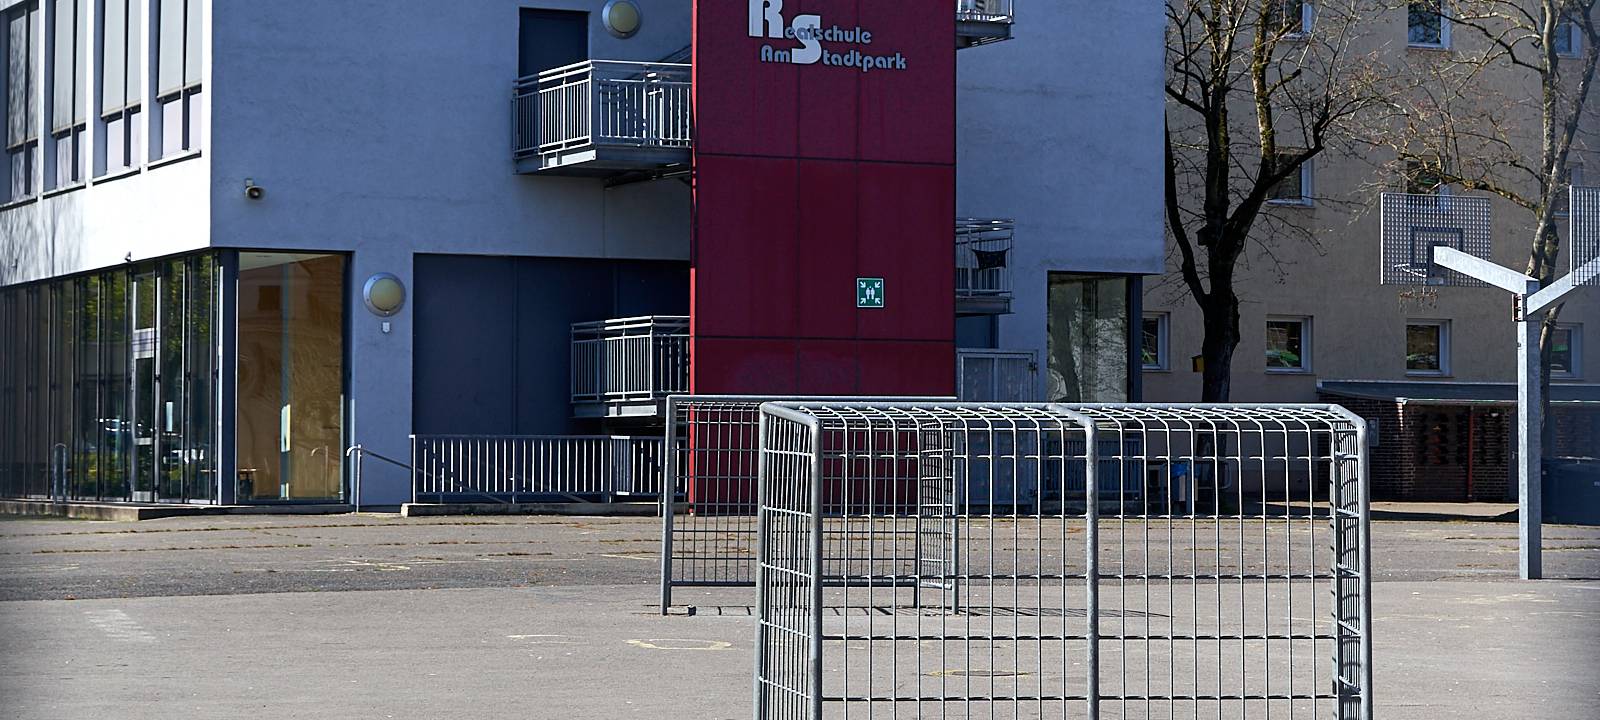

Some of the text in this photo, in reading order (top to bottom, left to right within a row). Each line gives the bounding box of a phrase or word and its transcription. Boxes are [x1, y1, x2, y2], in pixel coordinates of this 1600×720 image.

[748, 0, 872, 43] Realschule
[760, 14, 907, 72] Am Stadtpark
